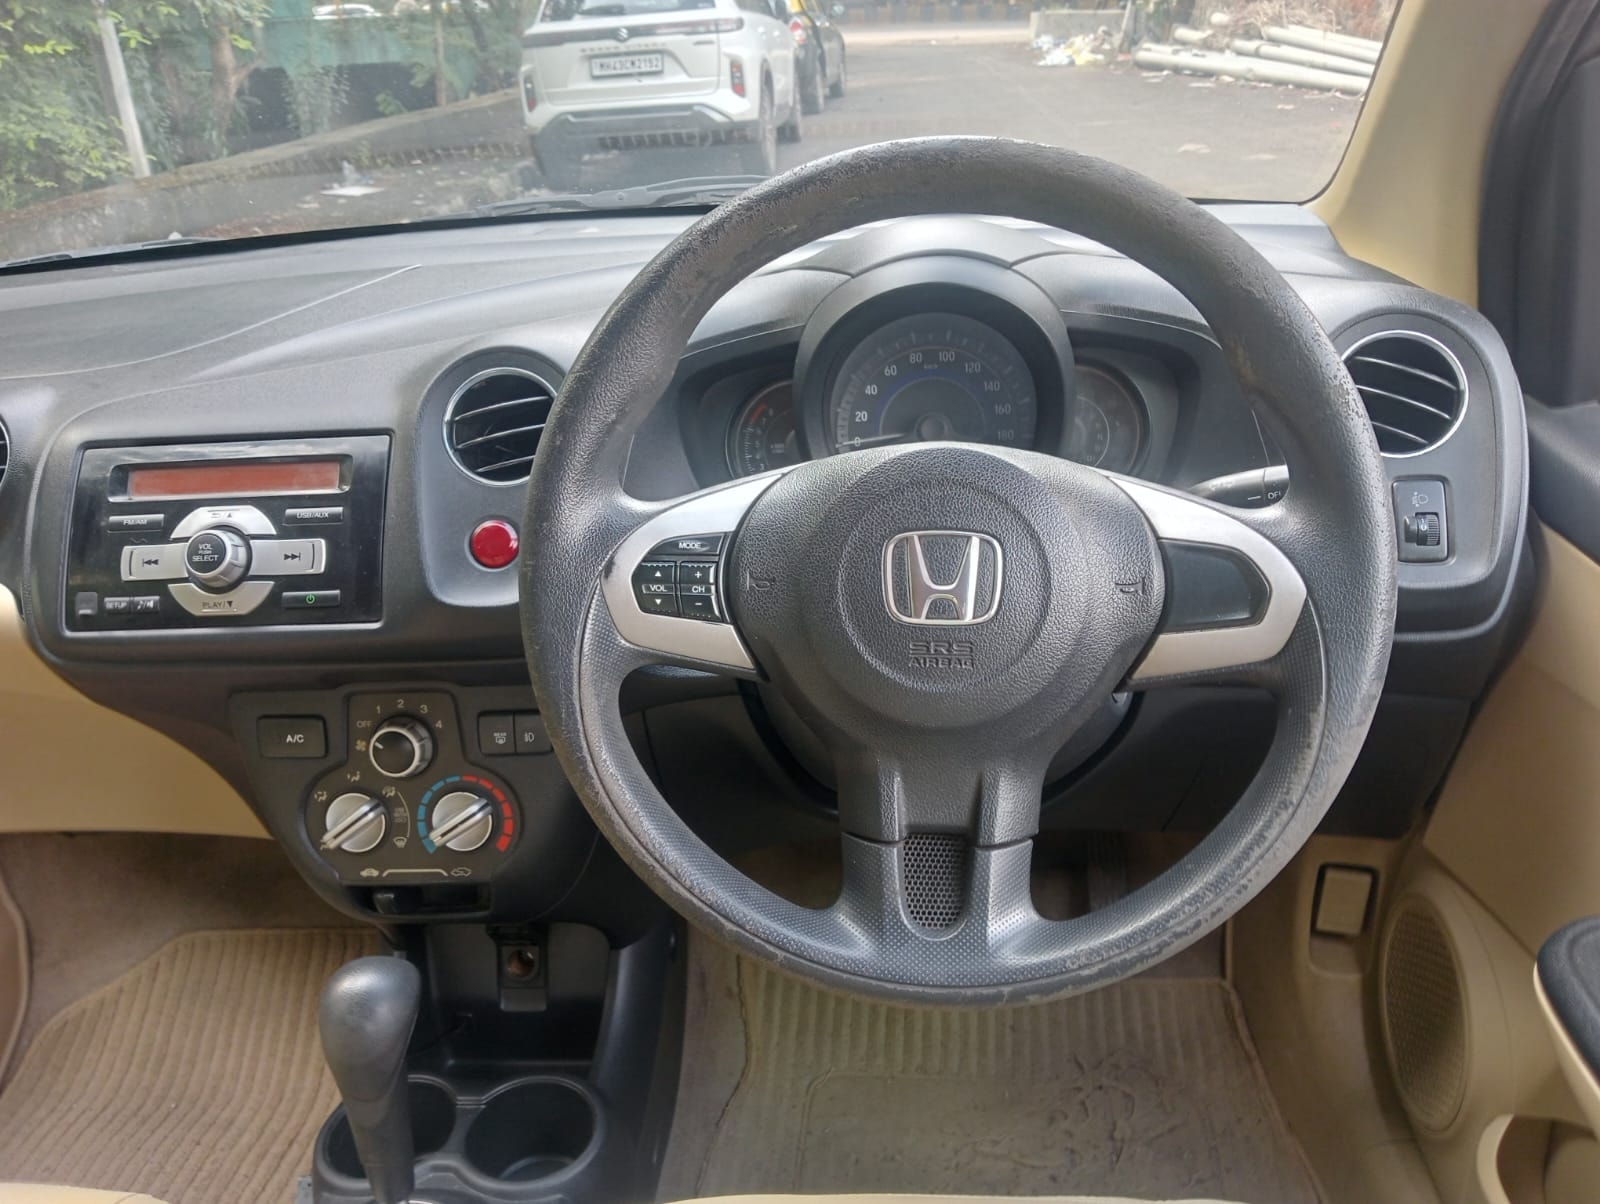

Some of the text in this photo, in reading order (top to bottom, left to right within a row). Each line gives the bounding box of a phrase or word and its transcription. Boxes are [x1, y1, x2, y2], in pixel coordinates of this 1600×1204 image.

[910, 352, 922, 363] 80
[938, 351, 955, 362] 100
[884, 364, 897, 376] 60
[965, 361, 981, 373] 120
[865, 384, 878, 395] 40
[983, 381, 1000, 392] 140
[994, 403, 1011, 415] 160
[855, 411, 868, 422] 20
[296, 511, 329, 520] USB/AUX
[649, 584, 668, 592] VOL
[691, 585, 705, 593] CH
[909, 640, 974, 656] SRS
[908, 656, 974, 669] AIRBAG
[397, 699, 405, 708] 2
[420, 704, 428, 714] 3
[376, 705, 381, 714] 1
[435, 720, 442, 729] 4
[286, 733, 305, 743] A/C
